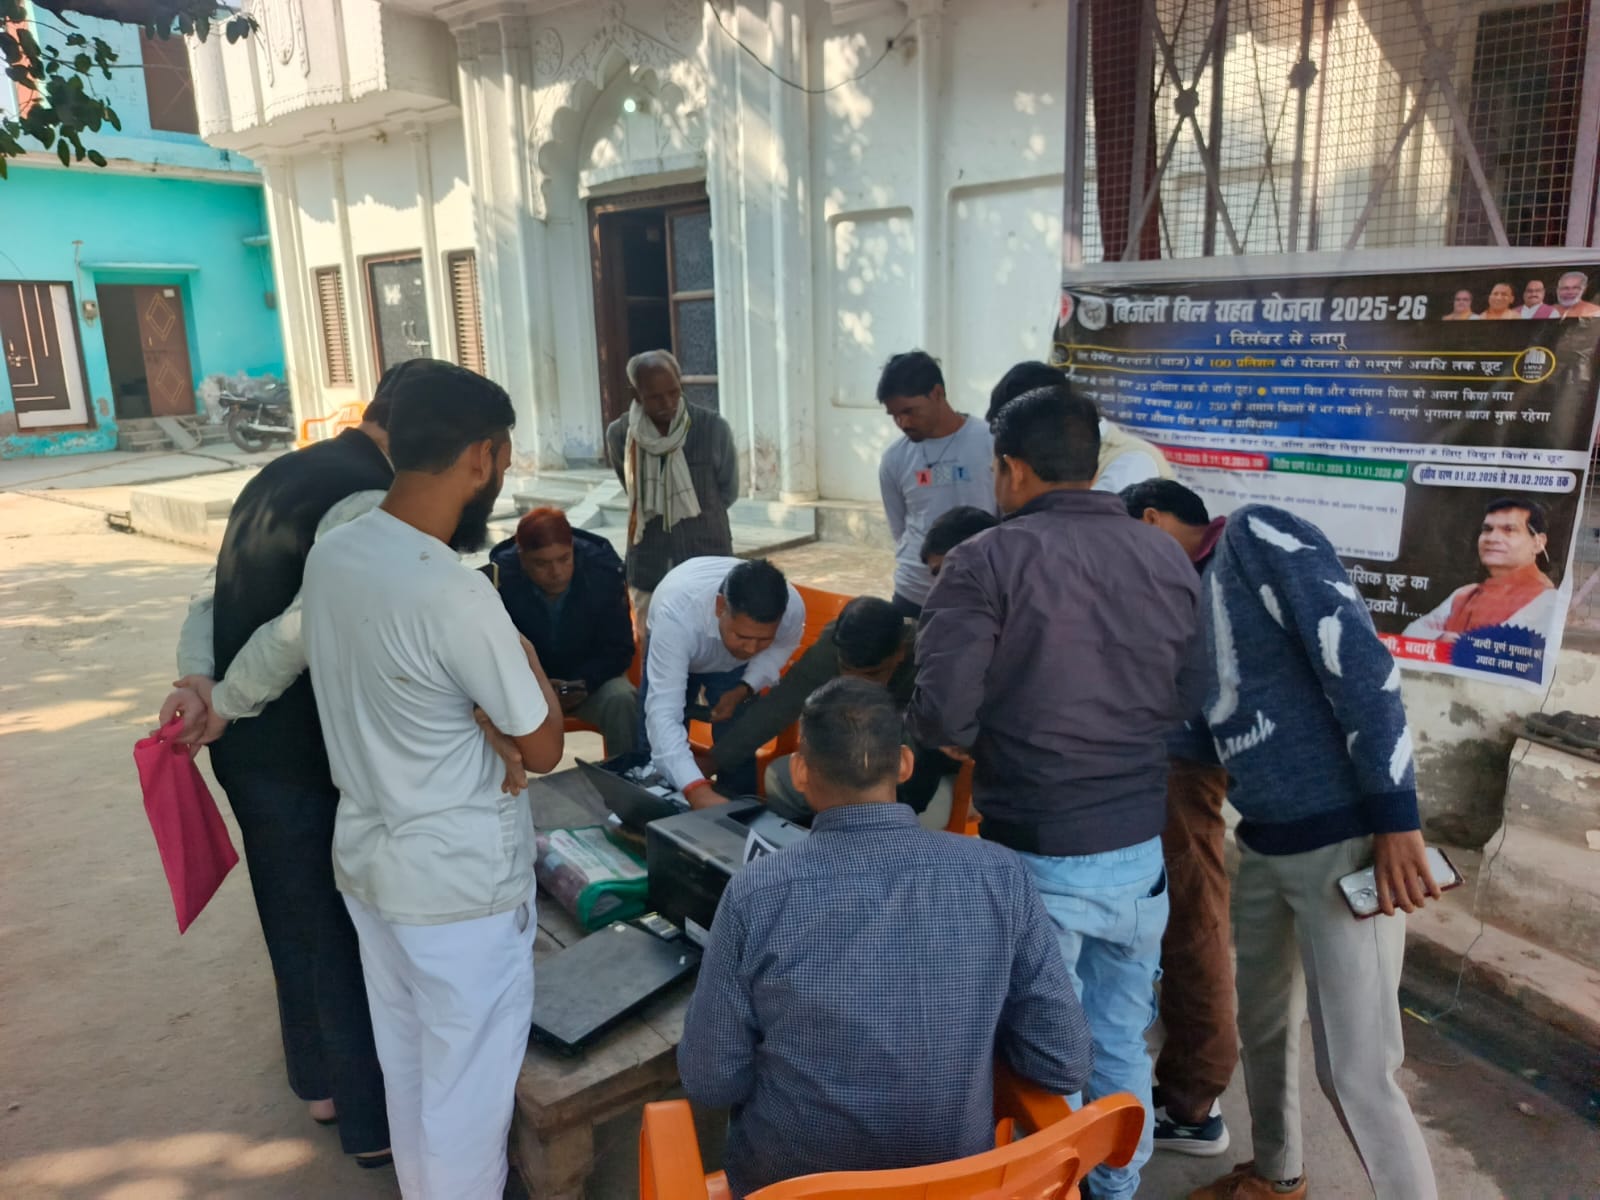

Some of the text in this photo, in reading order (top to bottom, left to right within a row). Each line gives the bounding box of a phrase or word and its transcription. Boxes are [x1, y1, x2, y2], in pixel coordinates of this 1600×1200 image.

[1113, 292, 1428, 323] बिजली बिल राहत योजना 2025-26
[1231, 329, 1283, 346] दिसंबर
[1288, 329, 1303, 345] से
[1310, 332, 1347, 350] लागू
[1210, 359, 1232, 368] 100
[1280, 357, 1295, 368] की
[1301, 357, 1340, 368] योजना
[1345, 356, 1360, 369] की
[1408, 357, 1448, 371] अवधि
[1452, 360, 1475, 371] तक
[1480, 360, 1503, 375] छूट
[1328, 383, 1345, 397] और
[1387, 386, 1408, 399] बिल
[1412, 387, 1426, 399] को
[1430, 389, 1459, 401] अलग
[1462, 387, 1490, 401] किया
[1492, 391, 1515, 401] गया
[1424, 410, 1461, 422] भुगतान
[1465, 410, 1490, 422] ब्याज
[1495, 410, 1518, 425] मुक्त
[1521, 408, 1552, 423] रहेगा
[1454, 472, 1498, 483] 01.02.2026
[1508, 472, 1554, 487] 28.02.2026
[1556, 475, 1570, 488] तक
[1386, 573, 1407, 593] छूट
[1410, 575, 1430, 591] का
[1497, 658, 1514, 670] लाभ
